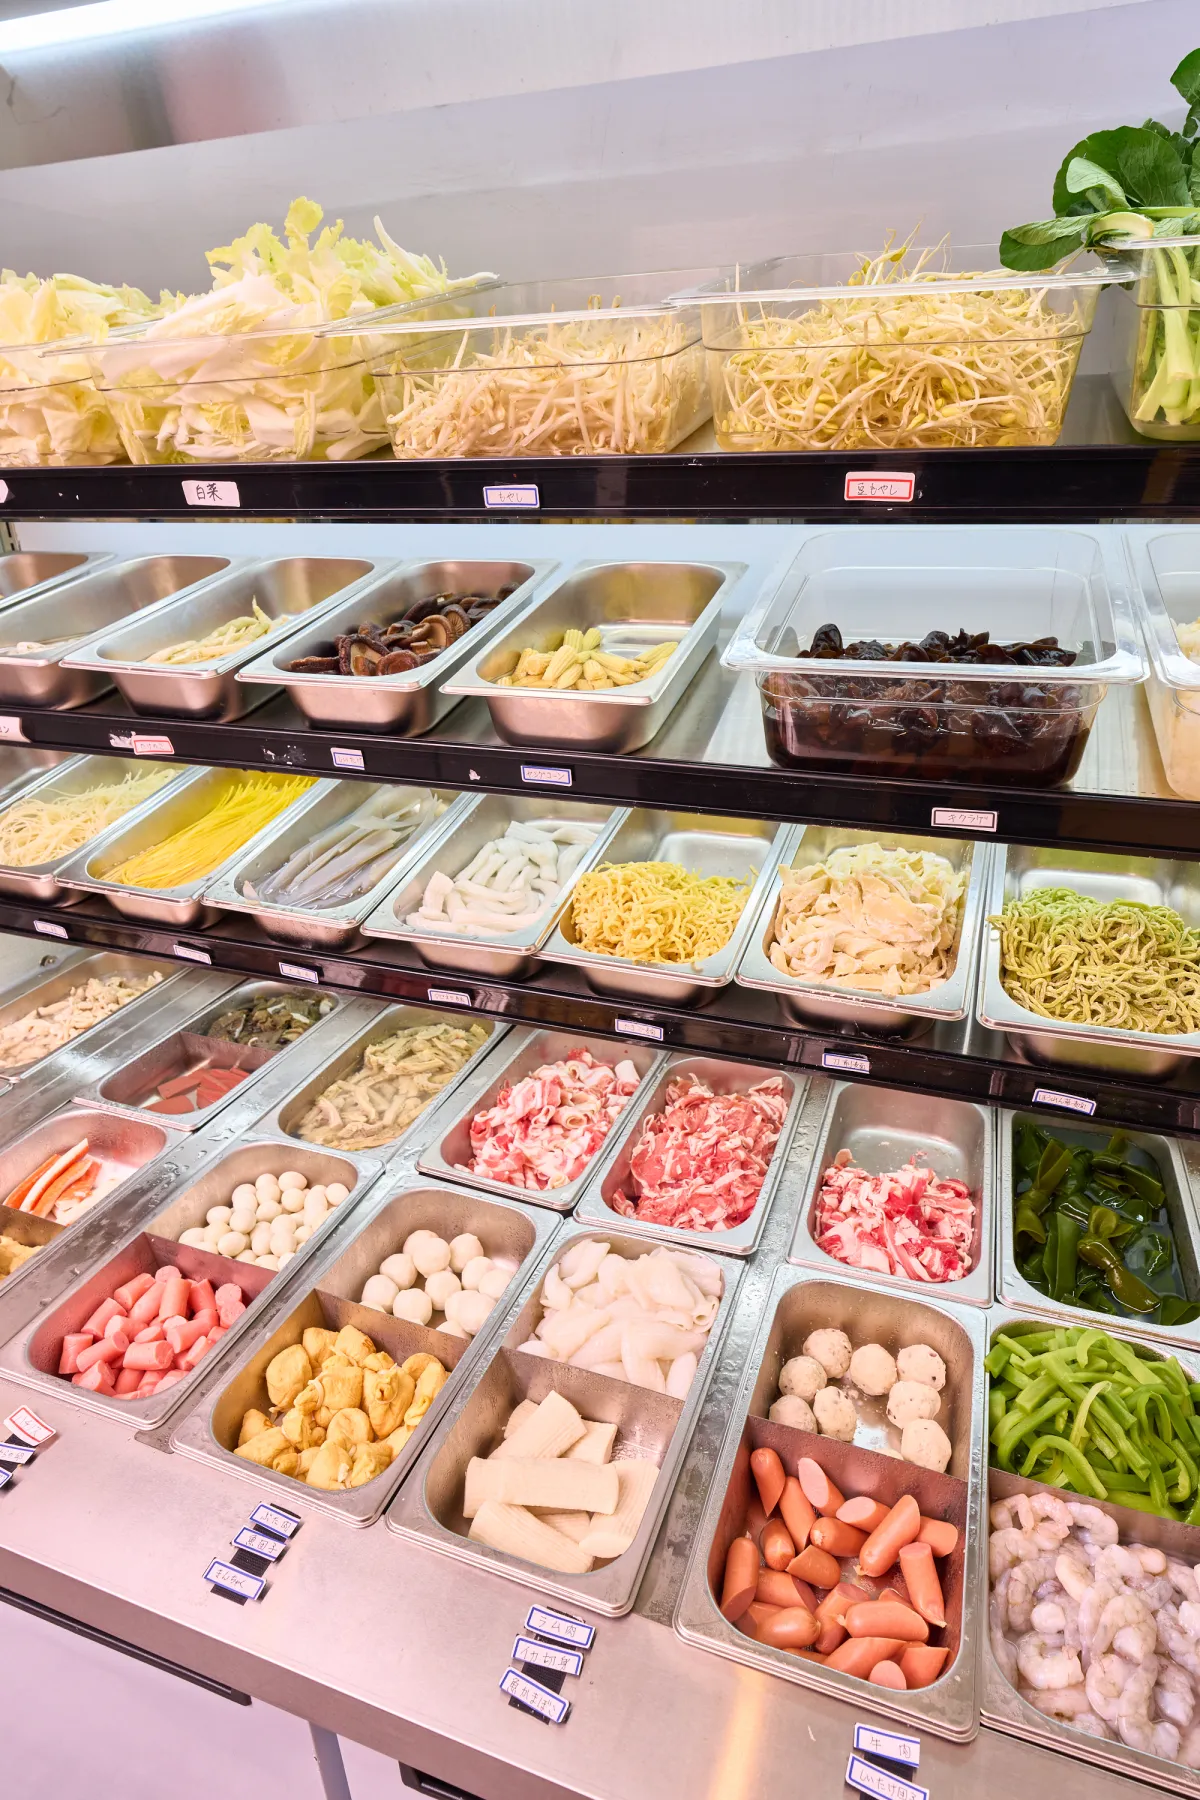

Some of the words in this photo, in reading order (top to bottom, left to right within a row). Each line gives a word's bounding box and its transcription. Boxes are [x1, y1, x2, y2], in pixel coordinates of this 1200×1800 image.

[195, 483, 223, 501] 白菜
[857, 482, 898, 496] 豆もやし
[498, 491, 523, 503] もやし
[947, 814, 989, 825] キクラゲ
